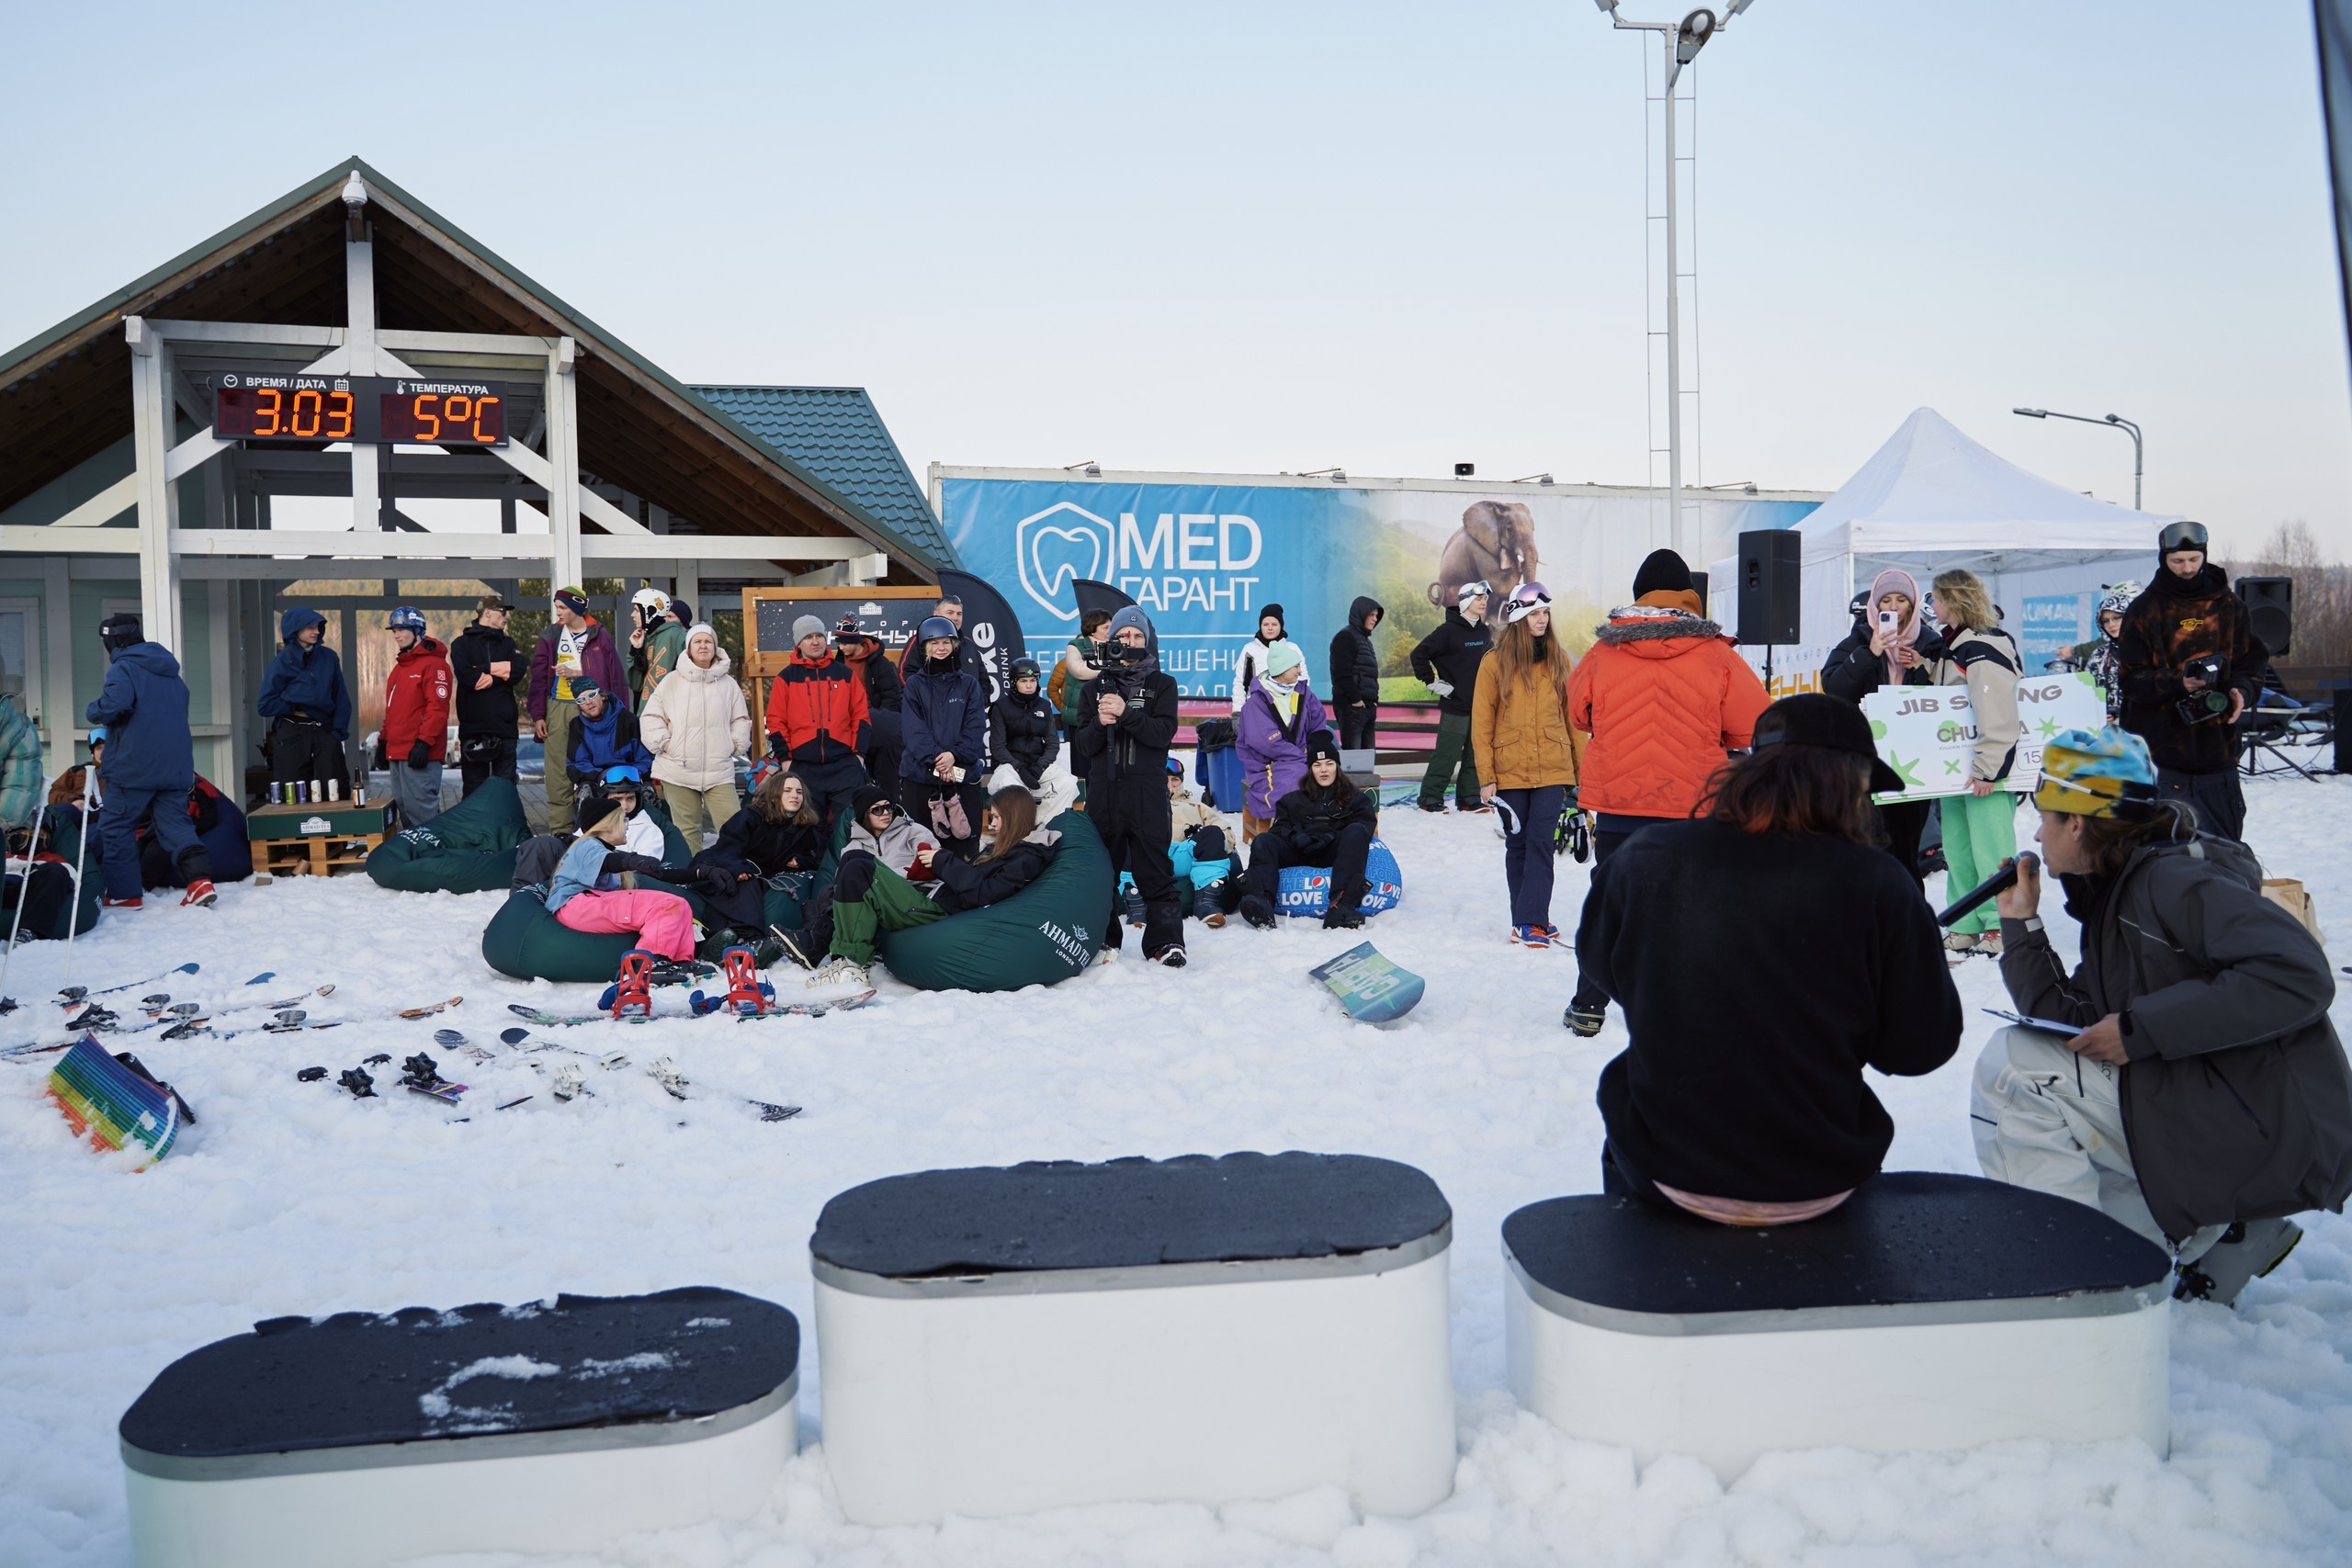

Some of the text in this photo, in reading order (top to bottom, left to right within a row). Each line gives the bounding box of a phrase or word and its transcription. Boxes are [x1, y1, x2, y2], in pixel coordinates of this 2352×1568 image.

[246, 378, 287, 388] ВРЕМЯ
[296, 378, 327, 389] ДАТА
[409, 383, 489, 395] ТЕМПЕРАТУРА
[254, 389, 354, 438] 3.03
[1119, 513, 1262, 570] MED
[1120, 577, 1260, 612] ГАРАНТ
[1000, 647, 1011, 689] DRINK
[1896, 684, 2063, 716] JIB SNG
[1937, 719, 2030, 743] CHUA
[1282, 892, 1322, 906] LOVE
[1362, 894, 1388, 909] OVE
[1038, 920, 1091, 968] AHMAD TEA
[1055, 948, 1075, 966] LONDON
